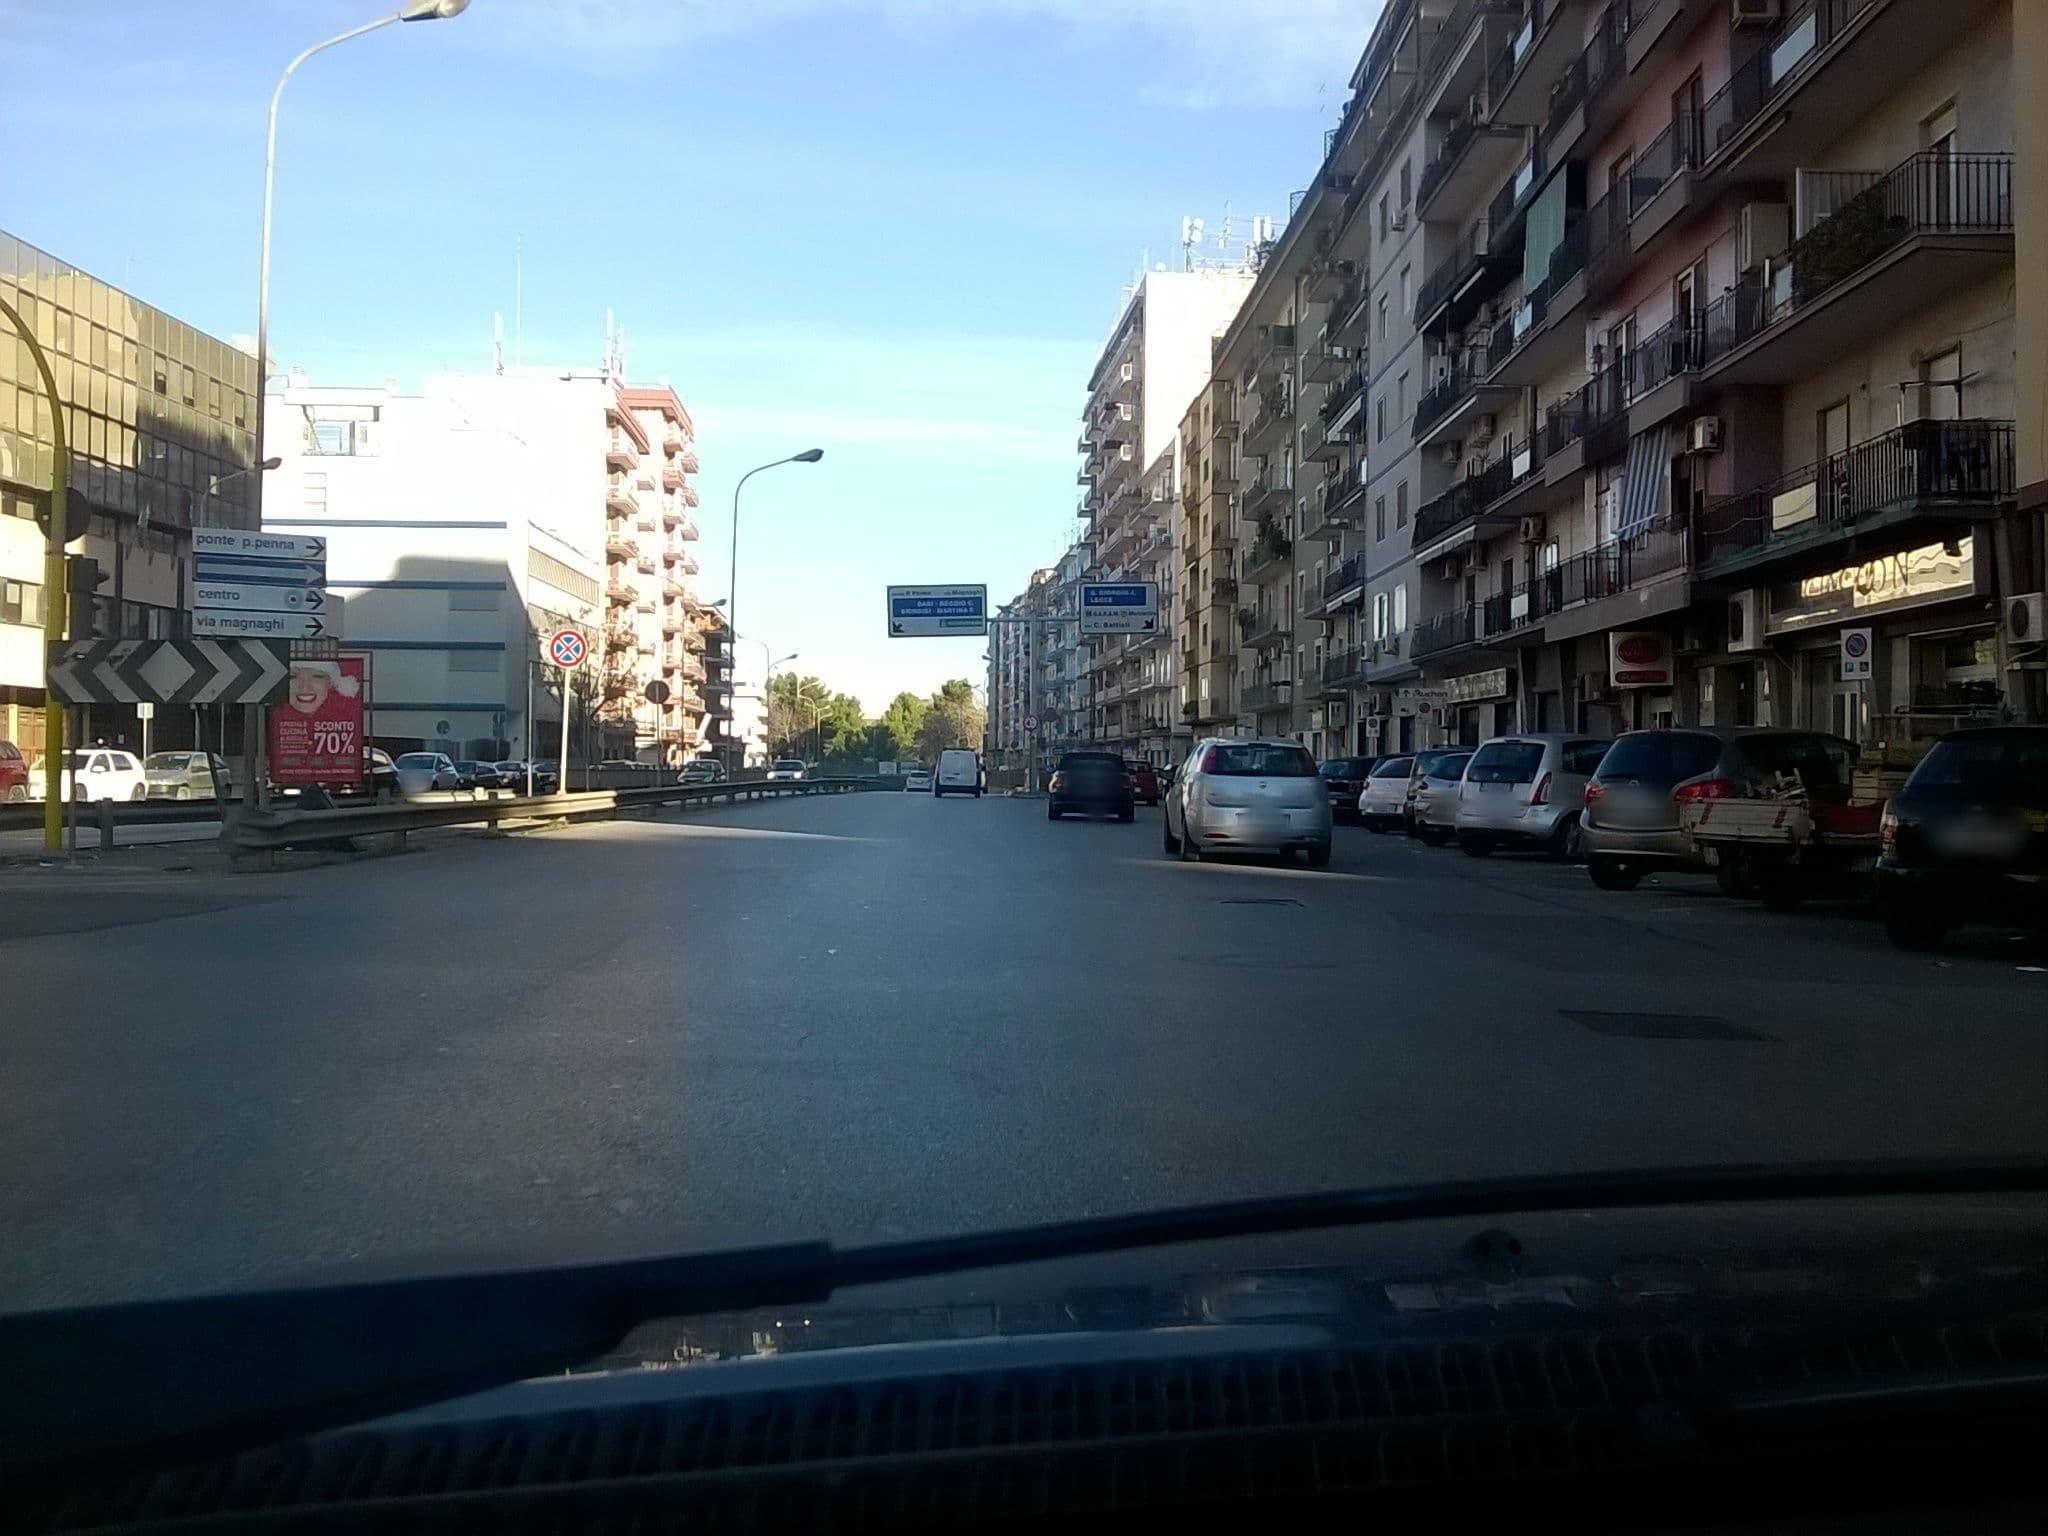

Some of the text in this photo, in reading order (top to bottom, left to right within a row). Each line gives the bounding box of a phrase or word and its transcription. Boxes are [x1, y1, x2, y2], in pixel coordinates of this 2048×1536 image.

[196, 534, 295, 550] ponte p.penna
[198, 588, 240, 601] centro
[197, 616, 284, 632] via magnaghi
[313, 721, 355, 731] SCONTO
[313, 732, 355, 755] 70%
